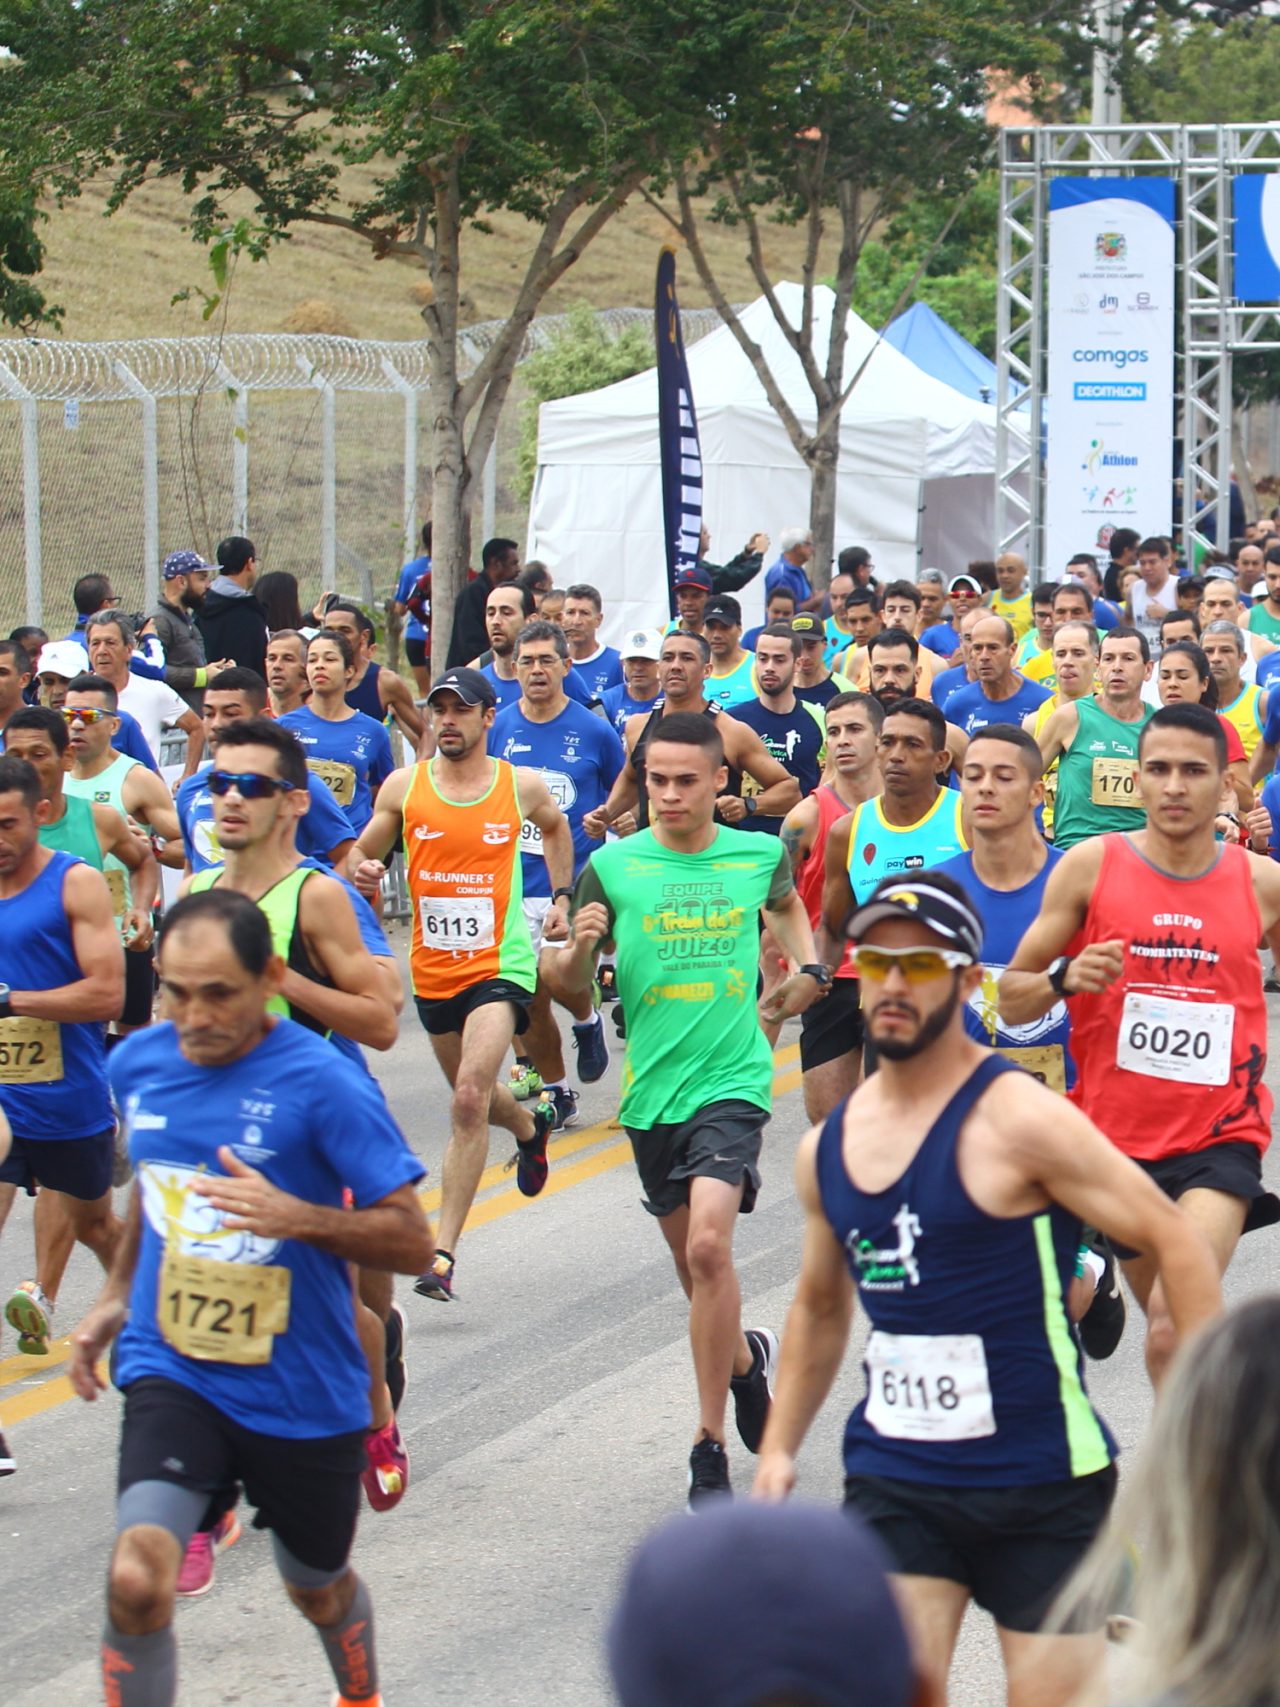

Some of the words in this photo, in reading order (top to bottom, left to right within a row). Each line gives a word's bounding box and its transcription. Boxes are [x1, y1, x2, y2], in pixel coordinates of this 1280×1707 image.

[1073, 350, 1149, 369] comgas
[1077, 386, 1144, 397] DECATHLON
[662, 882, 723, 897] EQUIPE
[427, 914, 479, 938] 6113
[1152, 913, 1203, 930] GRUPO
[1129, 1021, 1212, 1060] 6020
[168, 1289, 257, 1337] 1721
[882, 1370, 960, 1410] 6118
